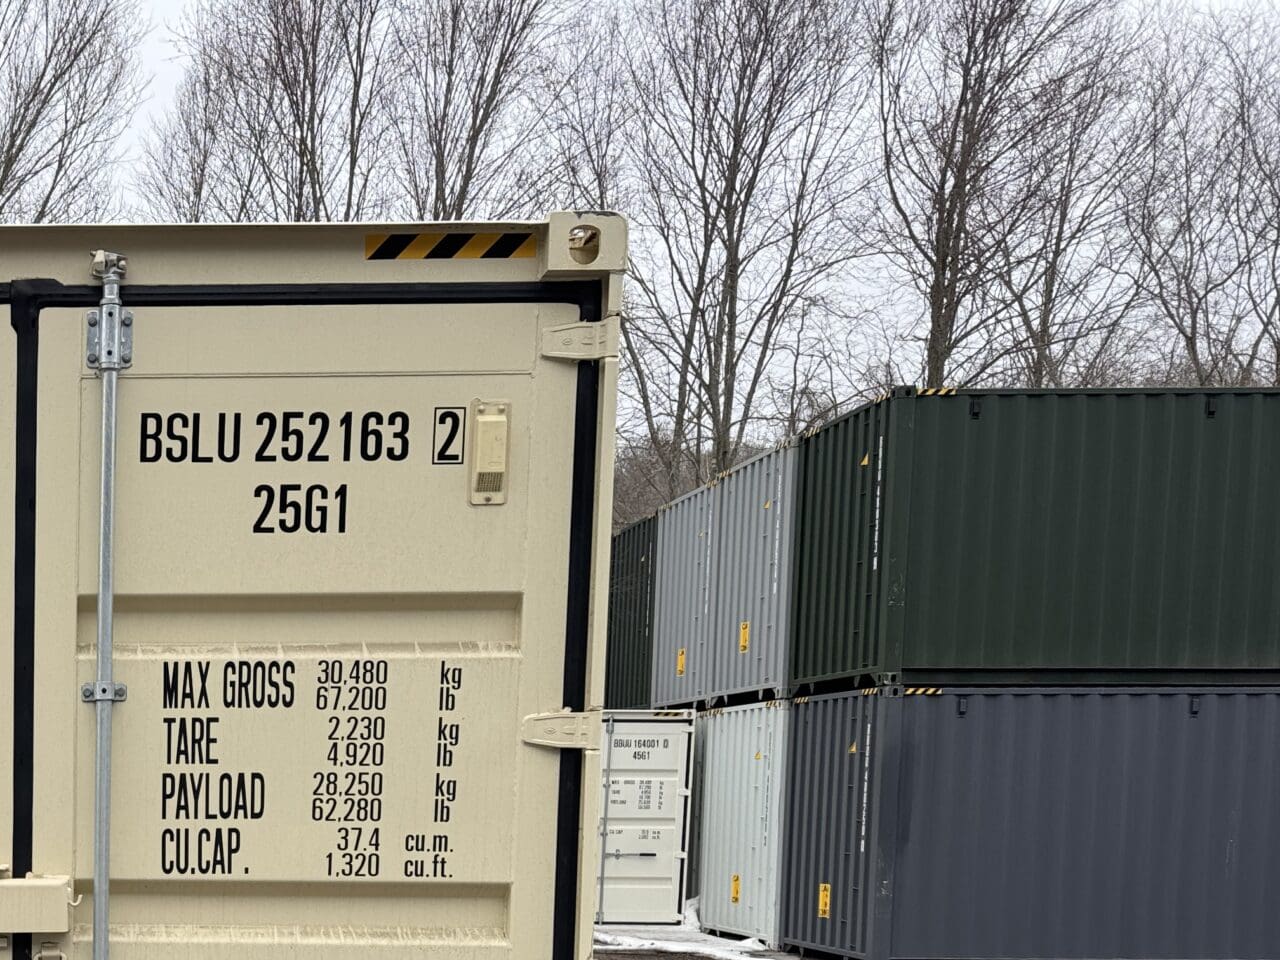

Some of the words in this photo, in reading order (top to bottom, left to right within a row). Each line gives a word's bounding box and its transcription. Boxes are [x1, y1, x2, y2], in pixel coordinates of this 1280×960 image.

[139, 411, 242, 463] BSLU
[255, 411, 410, 463] 252163
[435, 409, 463, 463] 2
[252, 484, 348, 534] 25G1
[162, 661, 210, 709] MAX
[223, 661, 296, 708] GROSS
[317, 660, 388, 686] 30,480
[440, 661, 462, 689] kg
[316, 687, 387, 712] 67,200
[438, 687, 456, 712] lb
[163, 717, 219, 765] TARE
[328, 716, 385, 743] 2,230
[438, 717, 460, 745] kg
[327, 742, 384, 769] 4,920
[436, 742, 453, 767] lb
[161, 772, 266, 820] PAYLOAD
[312, 772, 383, 798] 28,250
[434, 772, 457, 801] kg
[311, 798, 382, 824] 62,280
[433, 798, 450, 823] lb
[336, 827, 381, 853] 37.4
[404, 831, 454, 853] cu.m.
[325, 852, 381, 878] 1,320
[403, 853, 453, 878] cu.ft.
